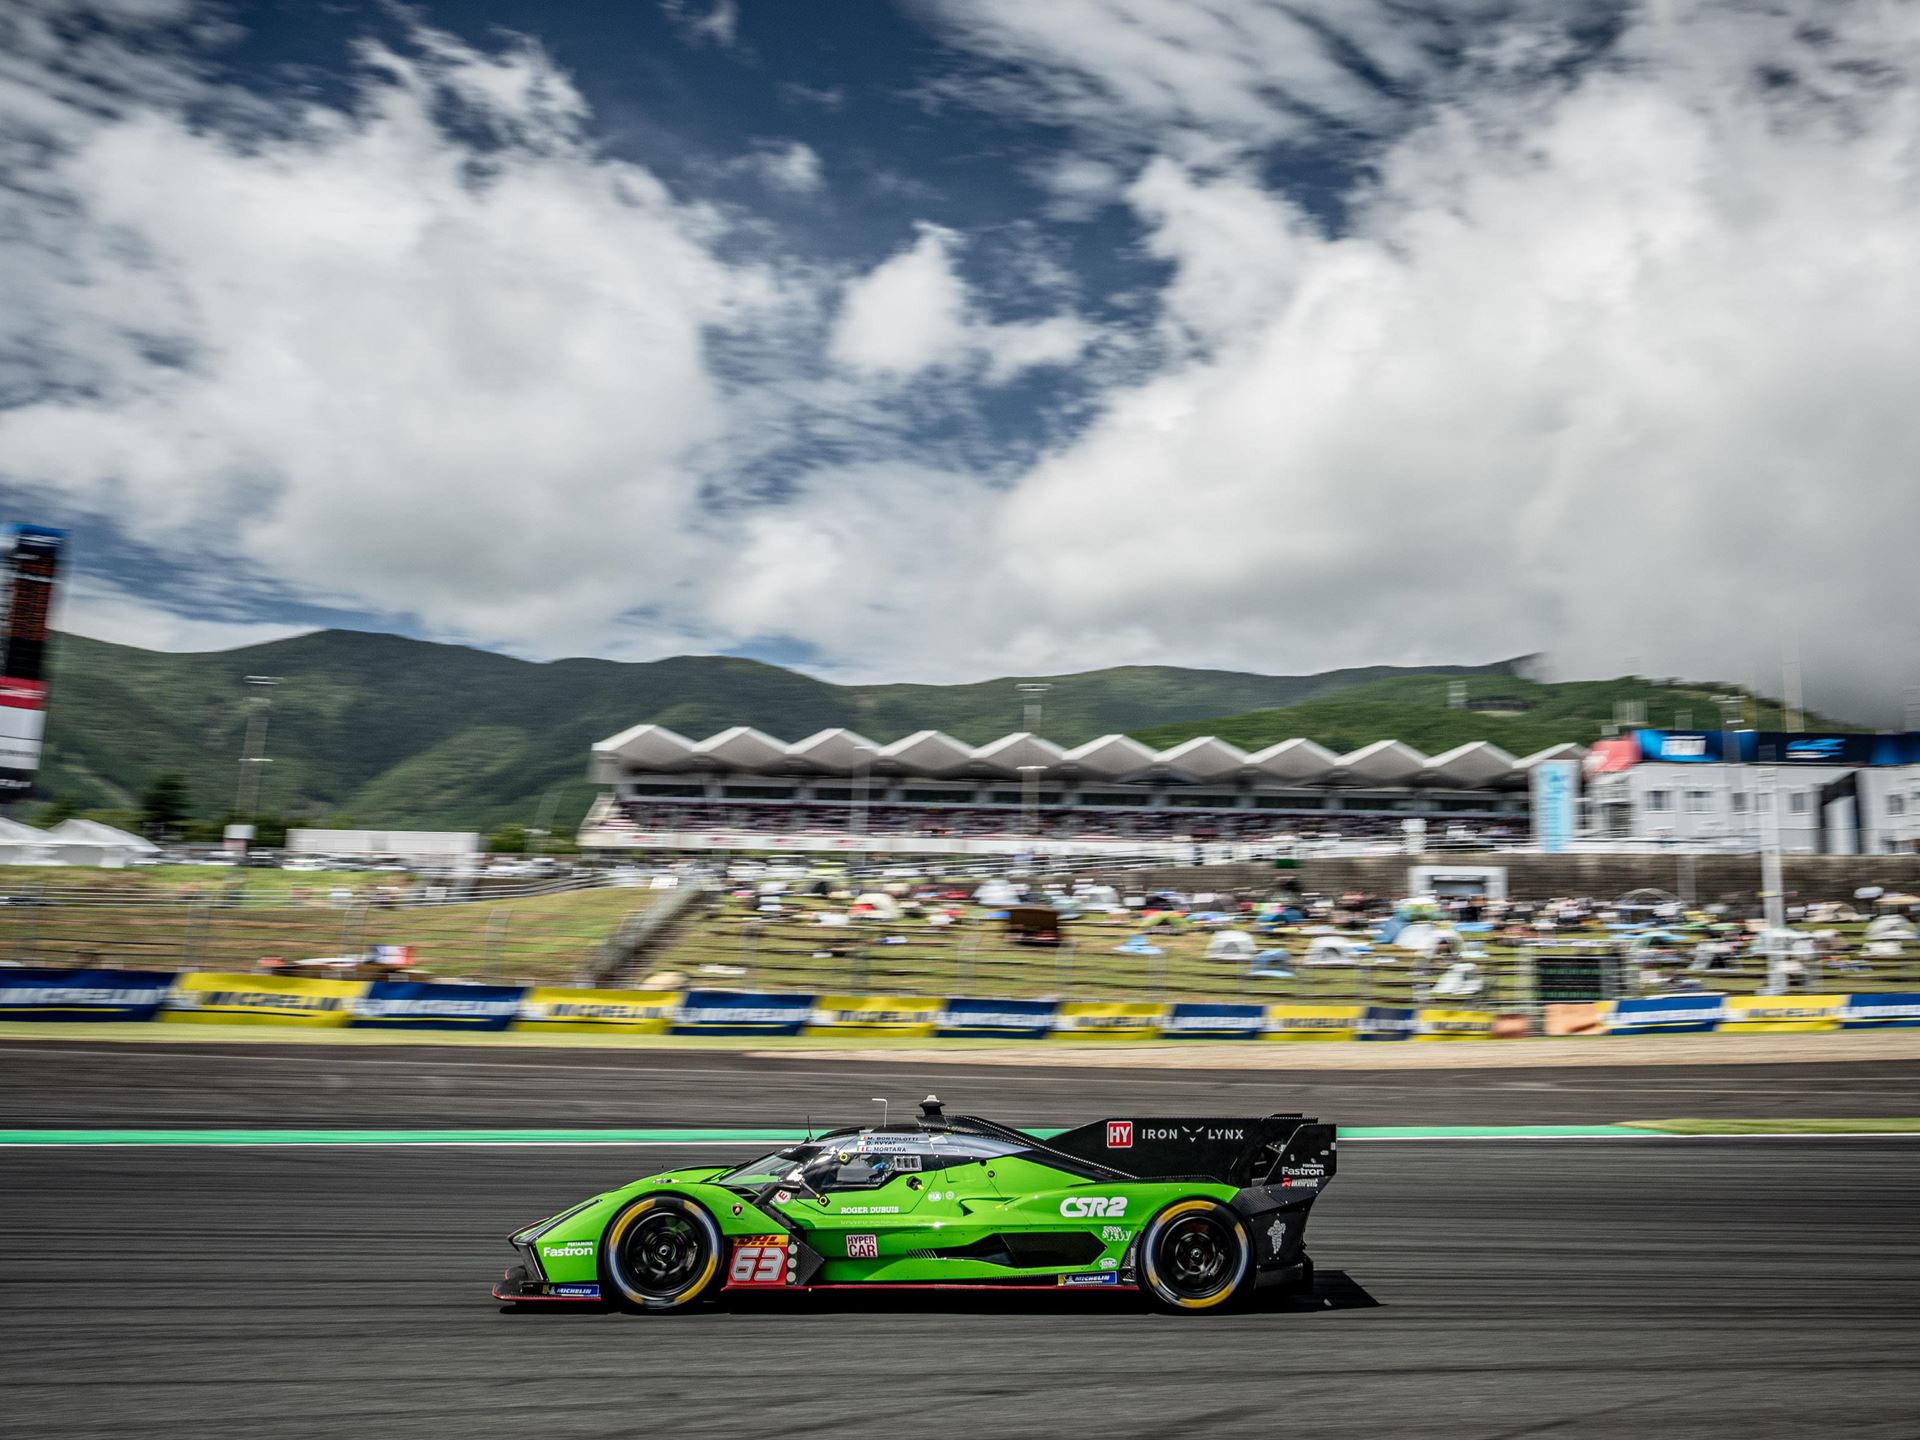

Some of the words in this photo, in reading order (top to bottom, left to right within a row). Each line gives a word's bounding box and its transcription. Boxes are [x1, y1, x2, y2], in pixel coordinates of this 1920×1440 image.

[1109, 1126, 1131, 1143] HY
[1142, 1129, 1178, 1140] IRON
[1208, 1129, 1244, 1140] LYNX
[1281, 1166, 1325, 1176] Fastron
[778, 1191, 788, 1201] E
[1060, 1196, 1128, 1218] CSR2
[735, 1236, 780, 1246] DHL
[847, 1236, 875, 1244] HYPER
[543, 1246, 593, 1257] Fastron
[849, 1245, 877, 1257] CAR
[731, 1247, 784, 1281] 63
